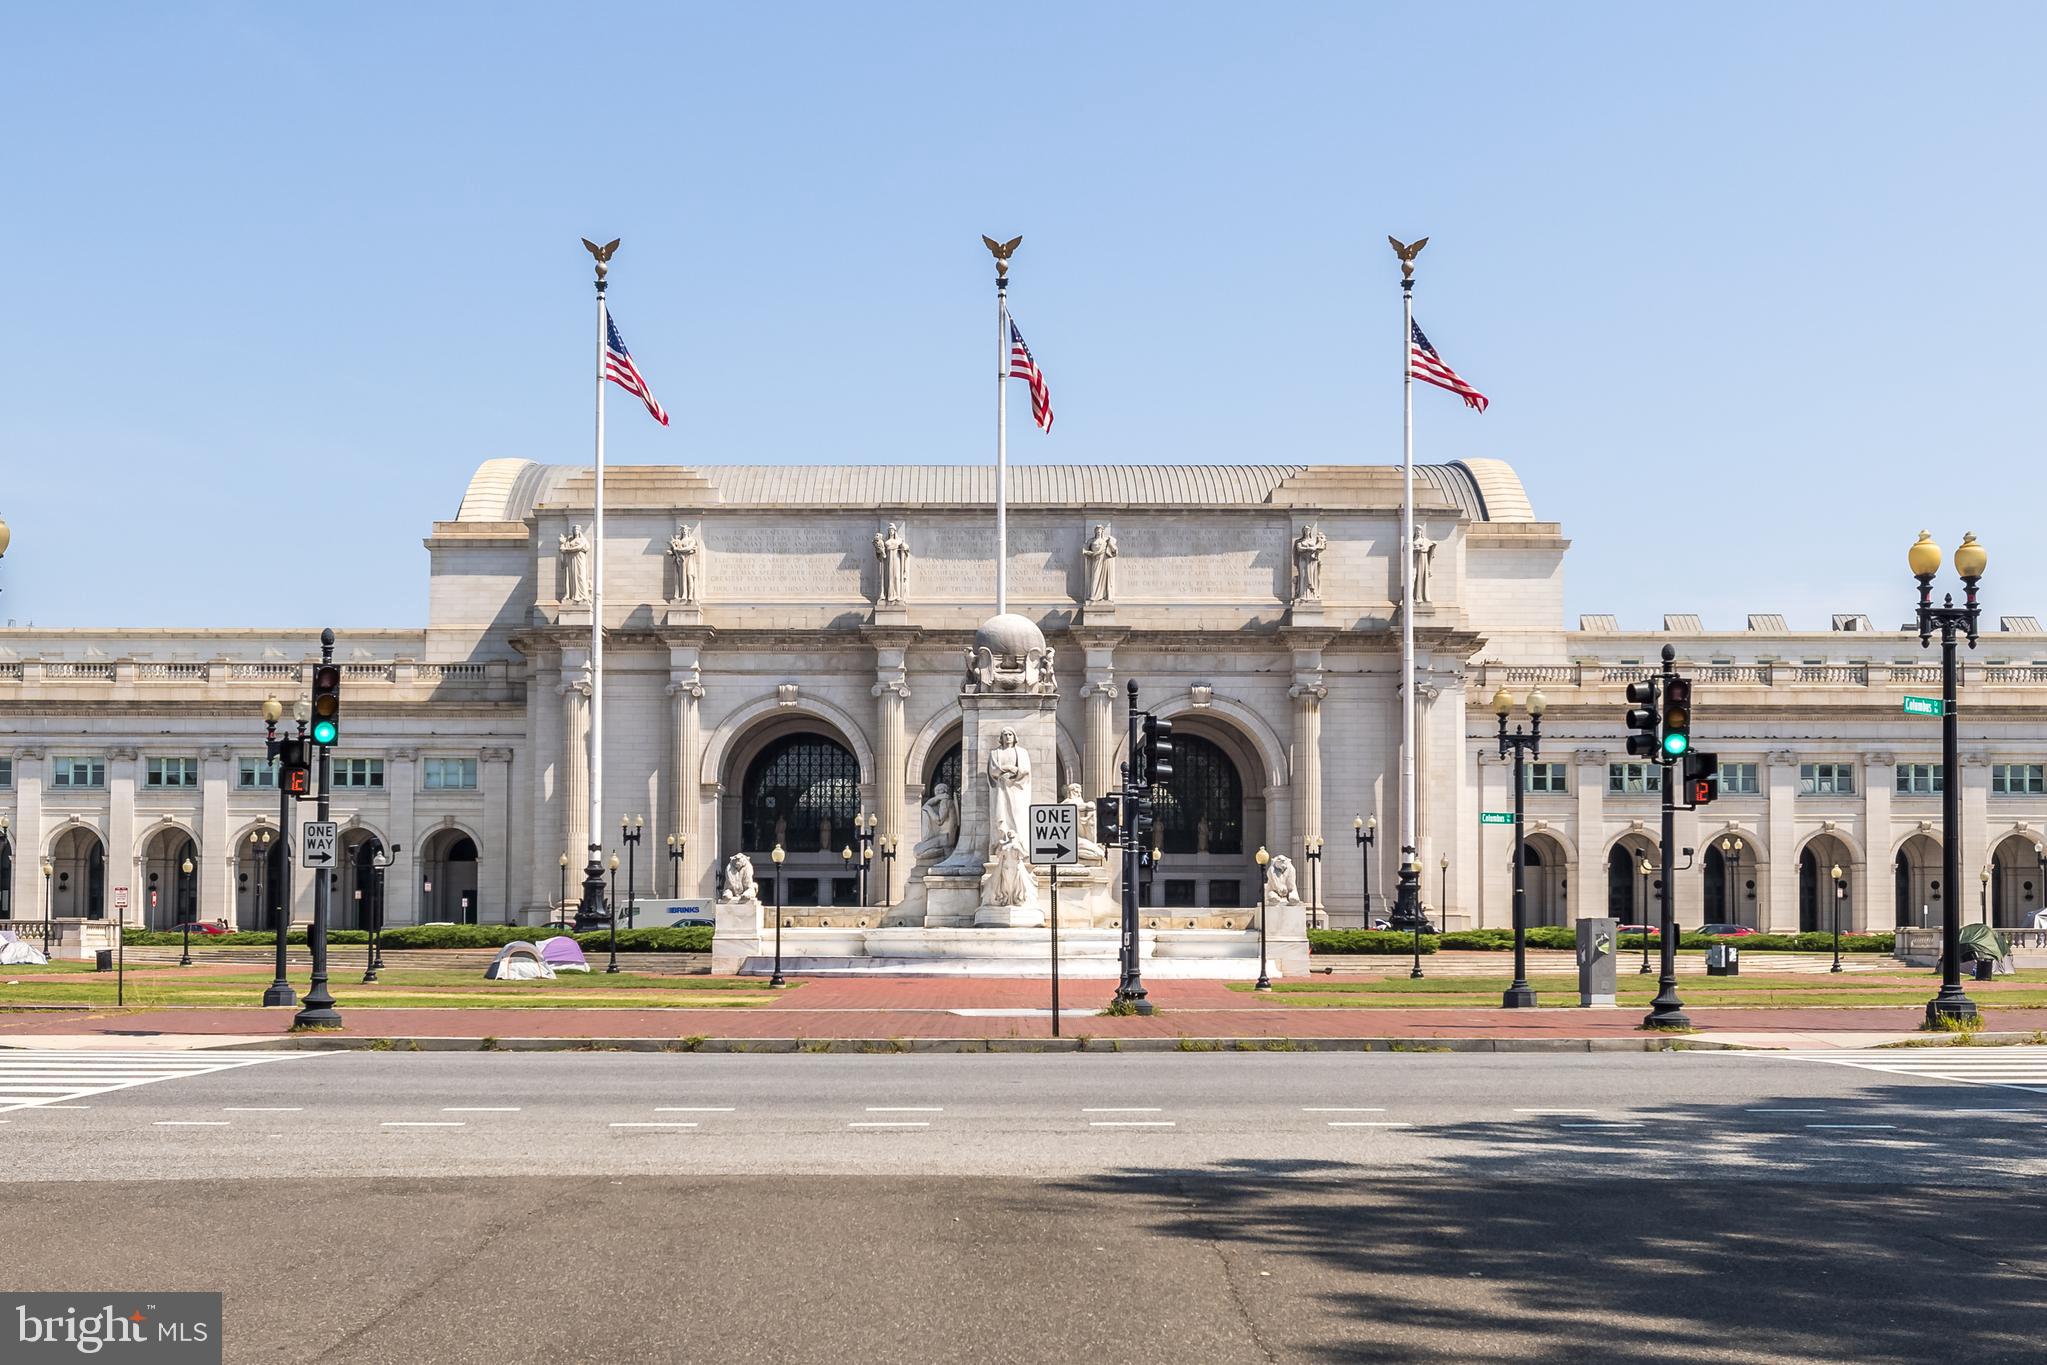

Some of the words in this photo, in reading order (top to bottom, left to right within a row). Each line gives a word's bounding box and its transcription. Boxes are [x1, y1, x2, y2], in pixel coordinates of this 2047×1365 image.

[1905, 698, 1932, 713] Columbus
[1036, 809, 1071, 824] ONE
[307, 826, 333, 837] ONE
[1035, 826, 1071, 840] WAY
[307, 839, 334, 850] WAY
